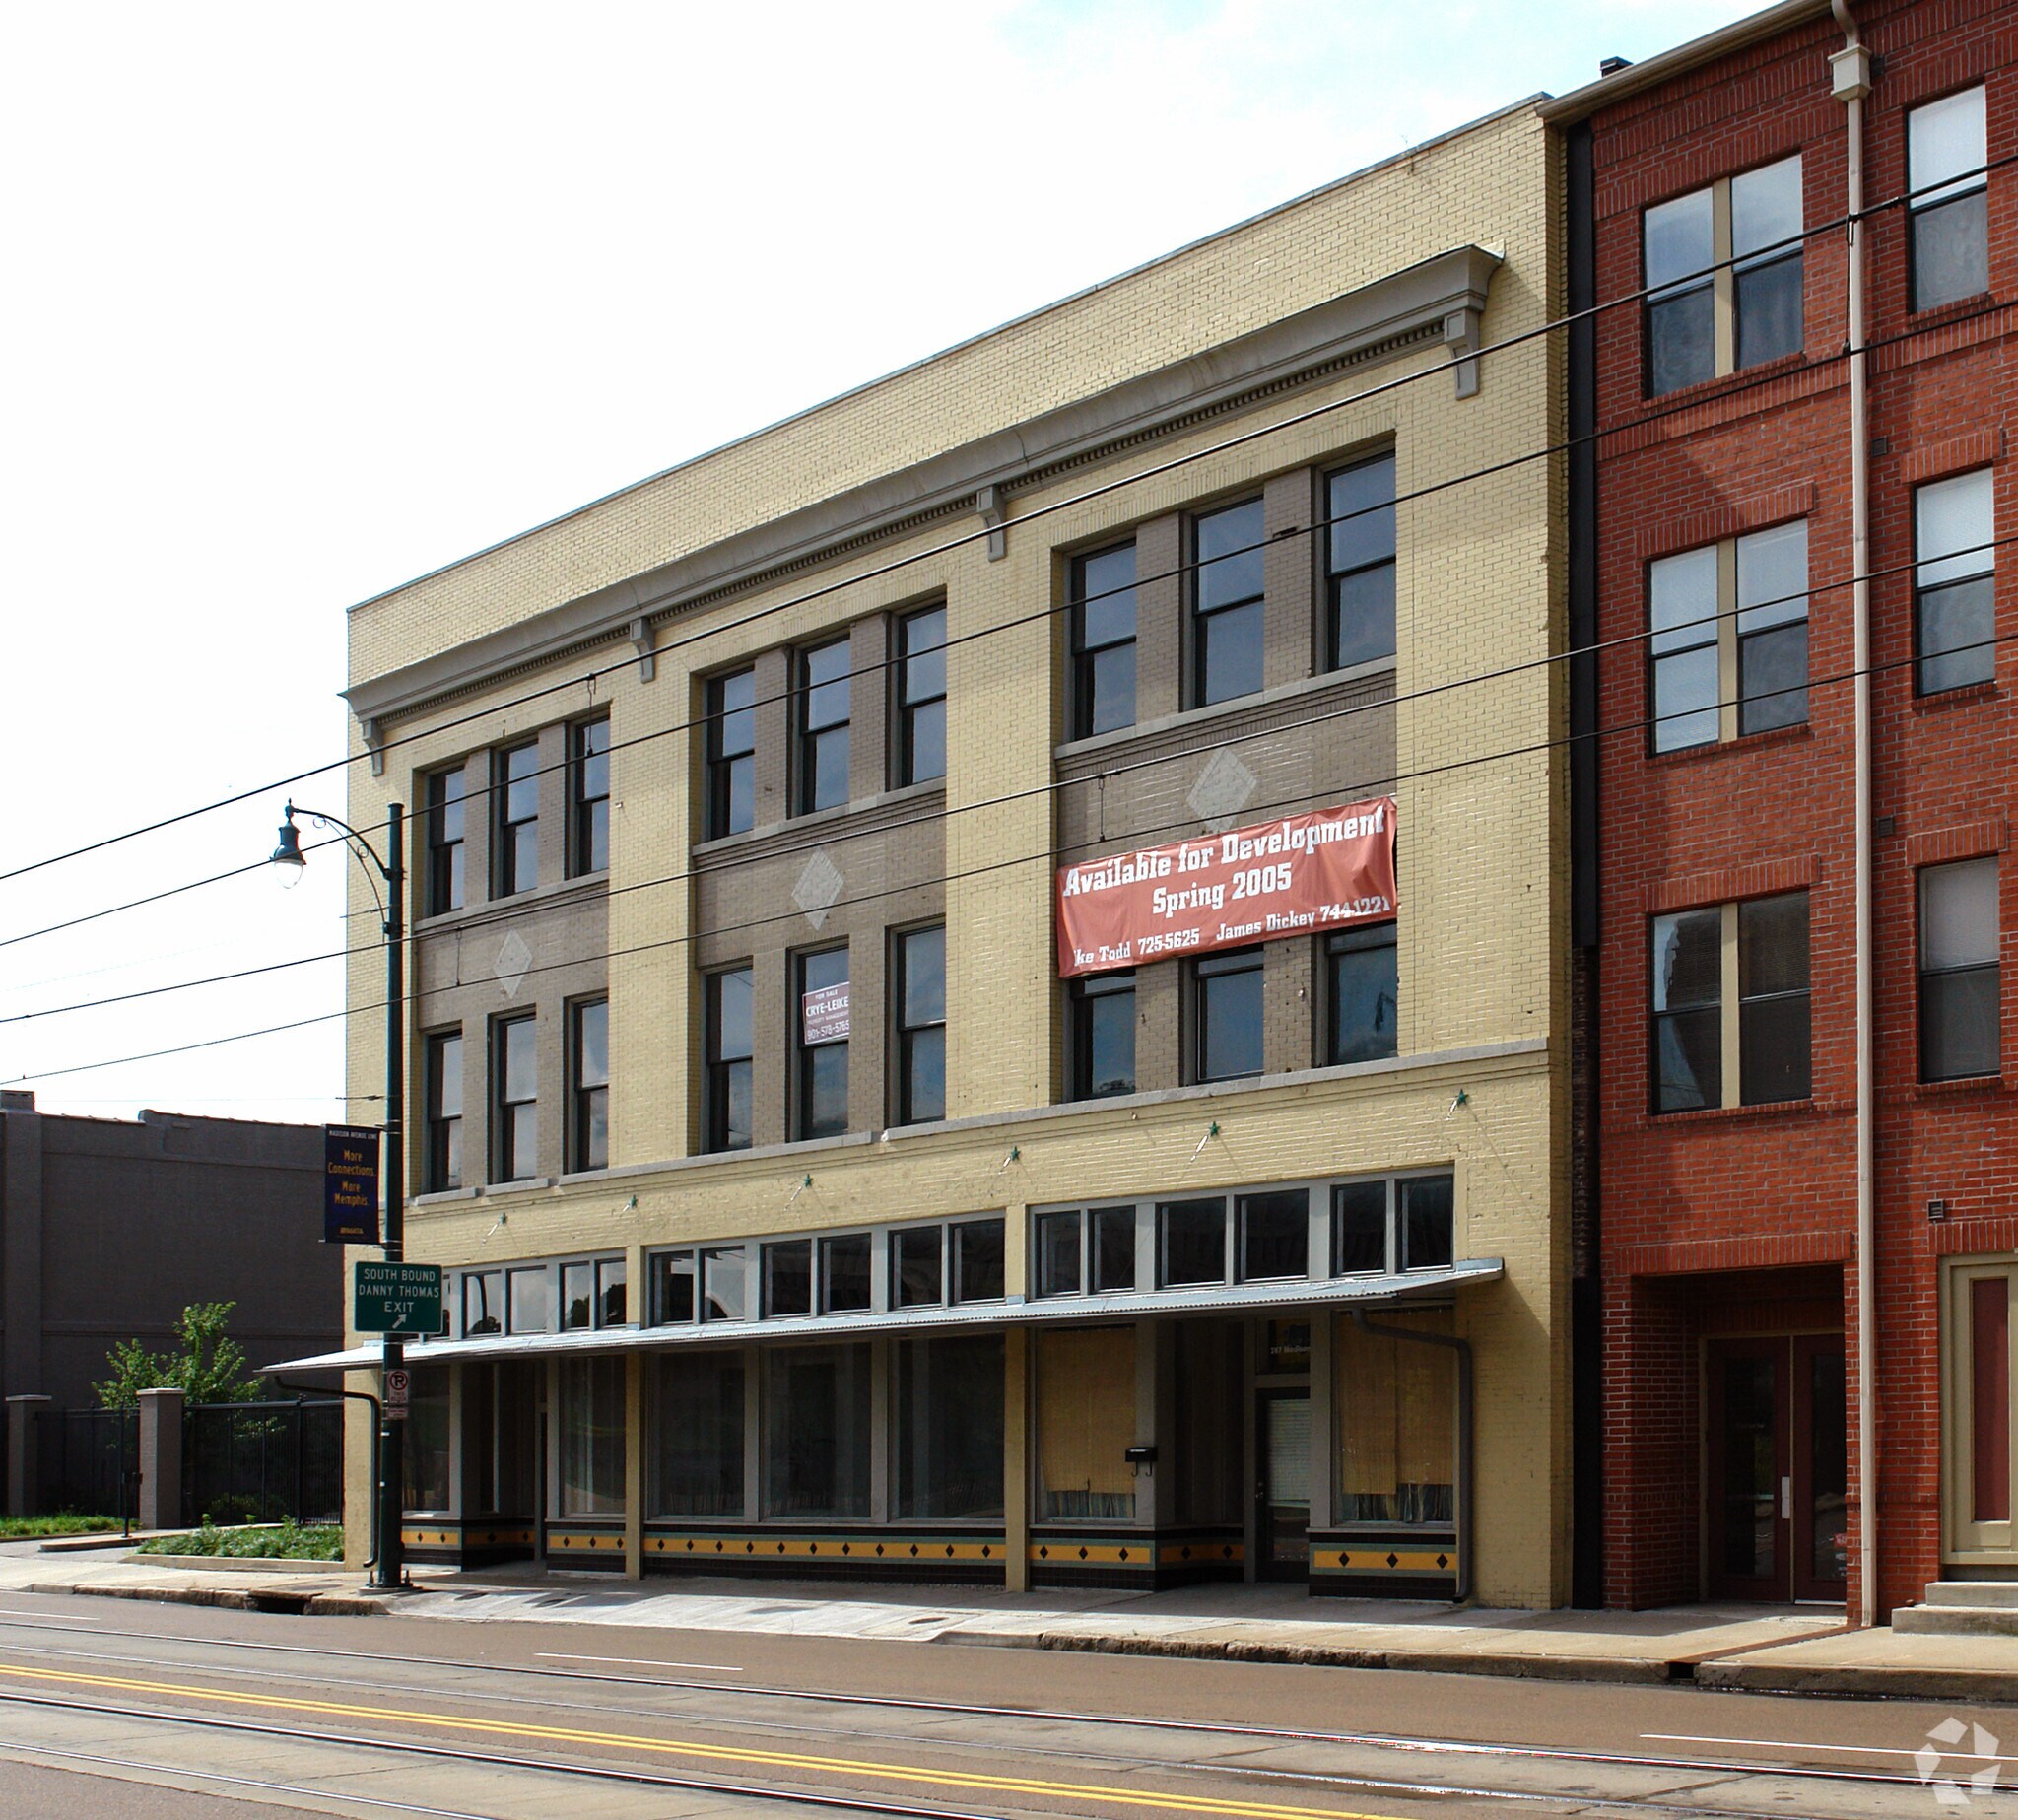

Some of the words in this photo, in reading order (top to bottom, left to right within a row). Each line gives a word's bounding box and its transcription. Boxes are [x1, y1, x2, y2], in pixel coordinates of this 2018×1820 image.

[1063, 851, 1172, 897] Available
[1178, 843, 1214, 873] for
[1221, 805, 1384, 864] Development
[1153, 882, 1225, 918] Spring
[1232, 863, 1292, 901] 2005
[1099, 941, 1131, 962] Todd
[1138, 928, 1200, 955] 725-5625
[1216, 920, 1262, 940] James
[1266, 910, 1315, 928] Dickey
[806, 996, 849, 1017] CRYE-LEIKE
[344, 1149, 363, 1162] More
[342, 1180, 361, 1193] More
[364, 1268, 397, 1281] SOUTH
[402, 1270, 436, 1282] BOUND
[359, 1284, 393, 1297] DANNY
[399, 1285, 439, 1299] THOMAS
[384, 1301, 415, 1313] EXIT
